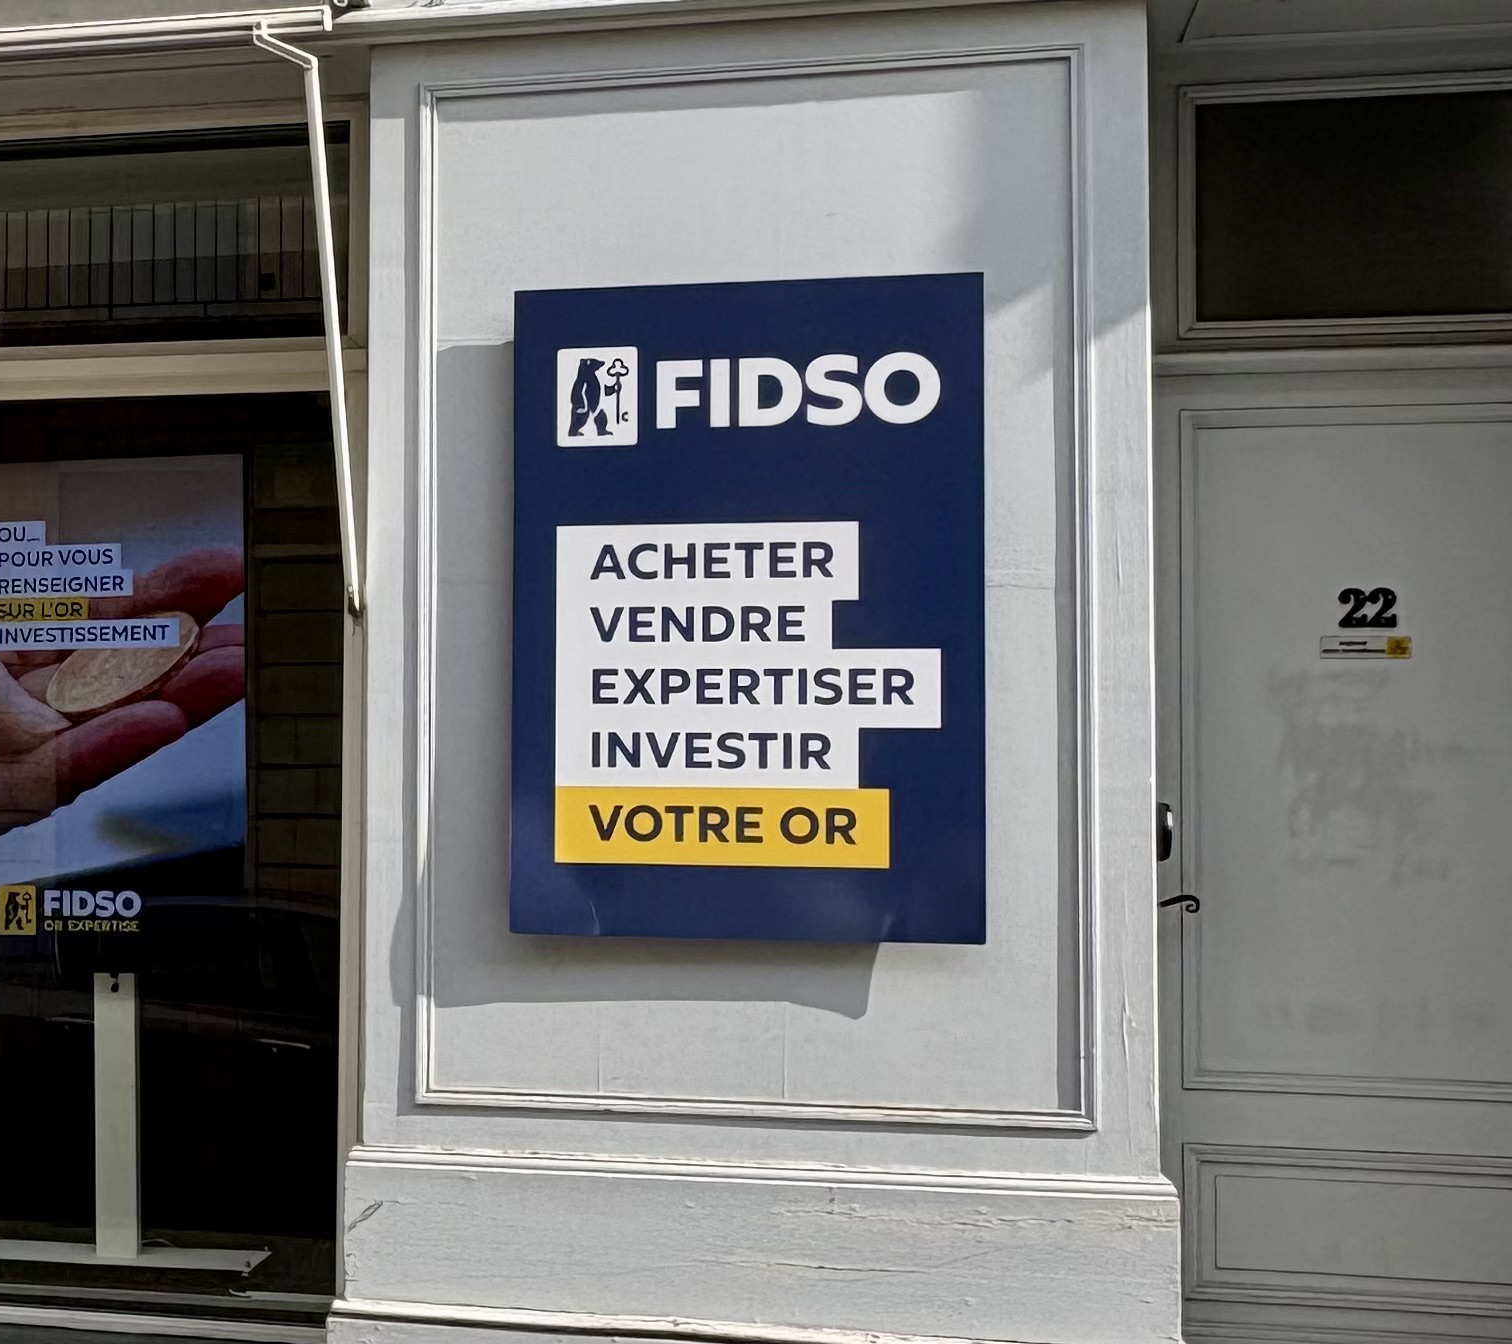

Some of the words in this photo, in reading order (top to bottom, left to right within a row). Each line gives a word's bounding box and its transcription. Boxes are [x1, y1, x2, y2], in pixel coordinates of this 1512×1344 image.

[655, 352, 941, 429] FIDSO
[58, 549, 114, 565] VOUS
[590, 541, 834, 581] ACHETER
[42, 602, 83, 617] L'OR
[589, 605, 806, 643] VENDRE
[1337, 587, 1398, 629] 22
[0, 625, 170, 644] INVESTISSEMENT
[592, 667, 915, 706] EXPERTISER
[591, 731, 831, 770] INVESTIR
[589, 804, 764, 844] VOTRE
[779, 807, 857, 845] OR
[43, 890, 142, 918] FIDSO
